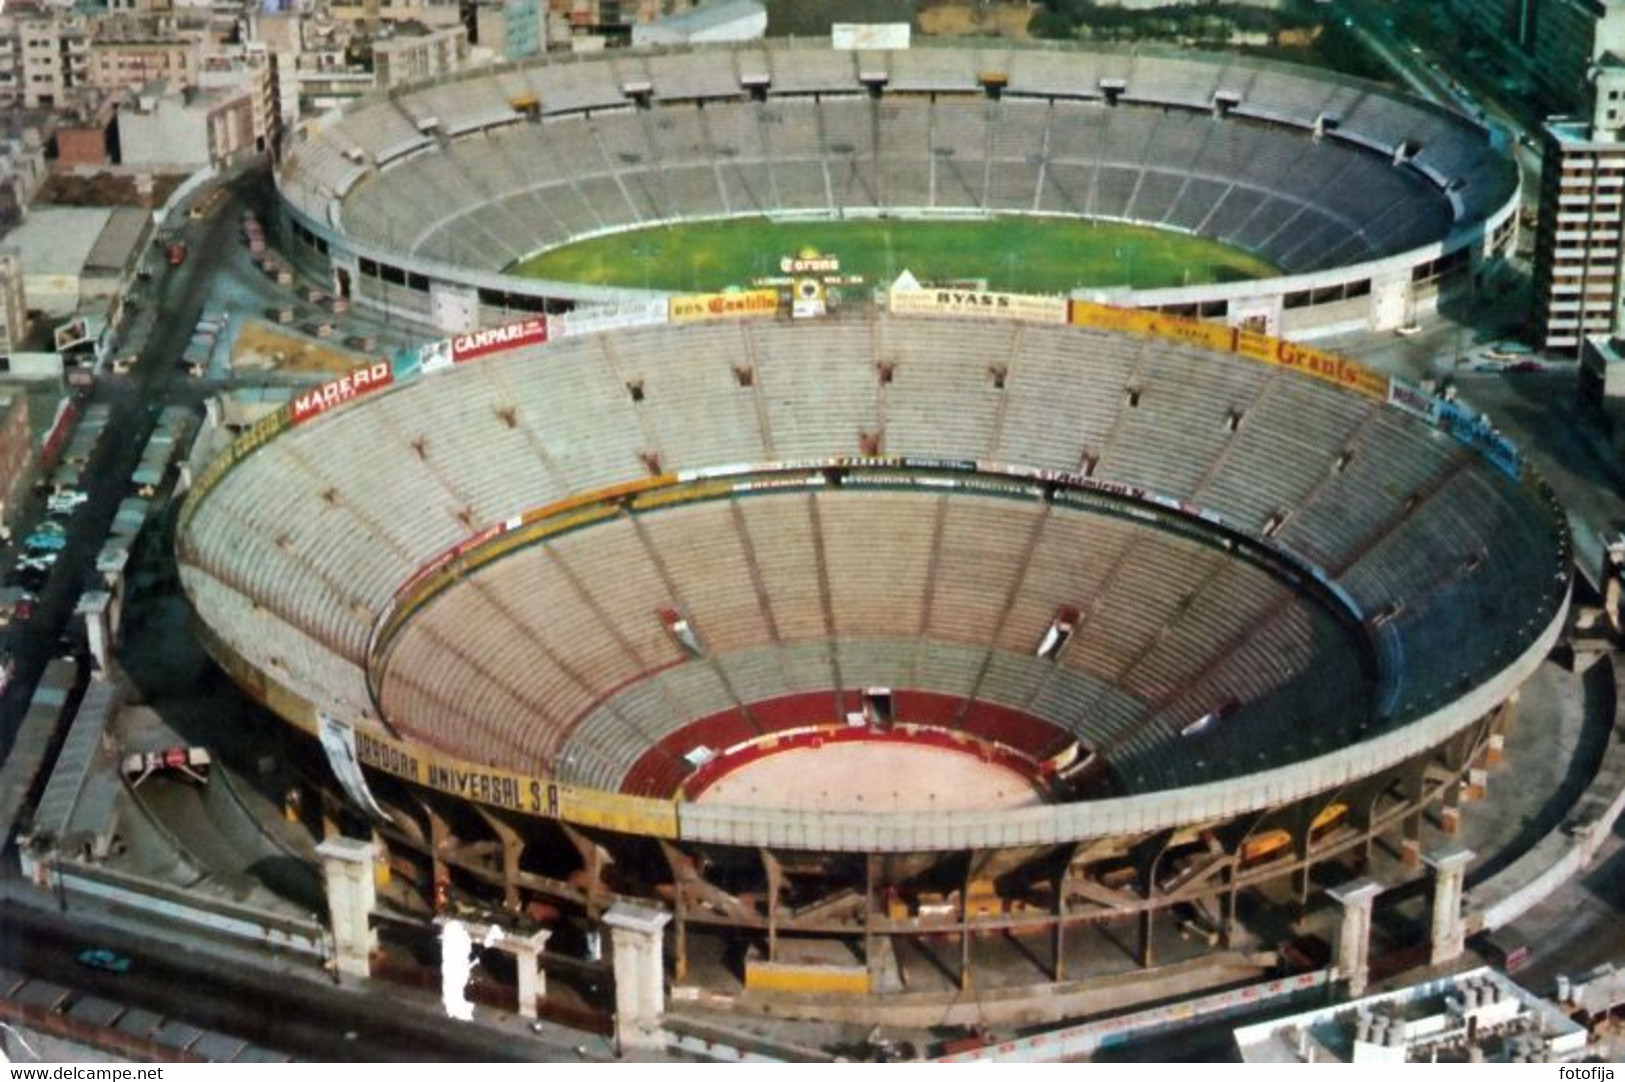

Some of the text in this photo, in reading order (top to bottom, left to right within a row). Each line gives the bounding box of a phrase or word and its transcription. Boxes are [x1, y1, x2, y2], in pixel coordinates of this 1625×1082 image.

[454, 322, 524, 353] CAMPARI
[295, 362, 388, 415] MADERO
[428, 763, 523, 809] UNIVERSAL
